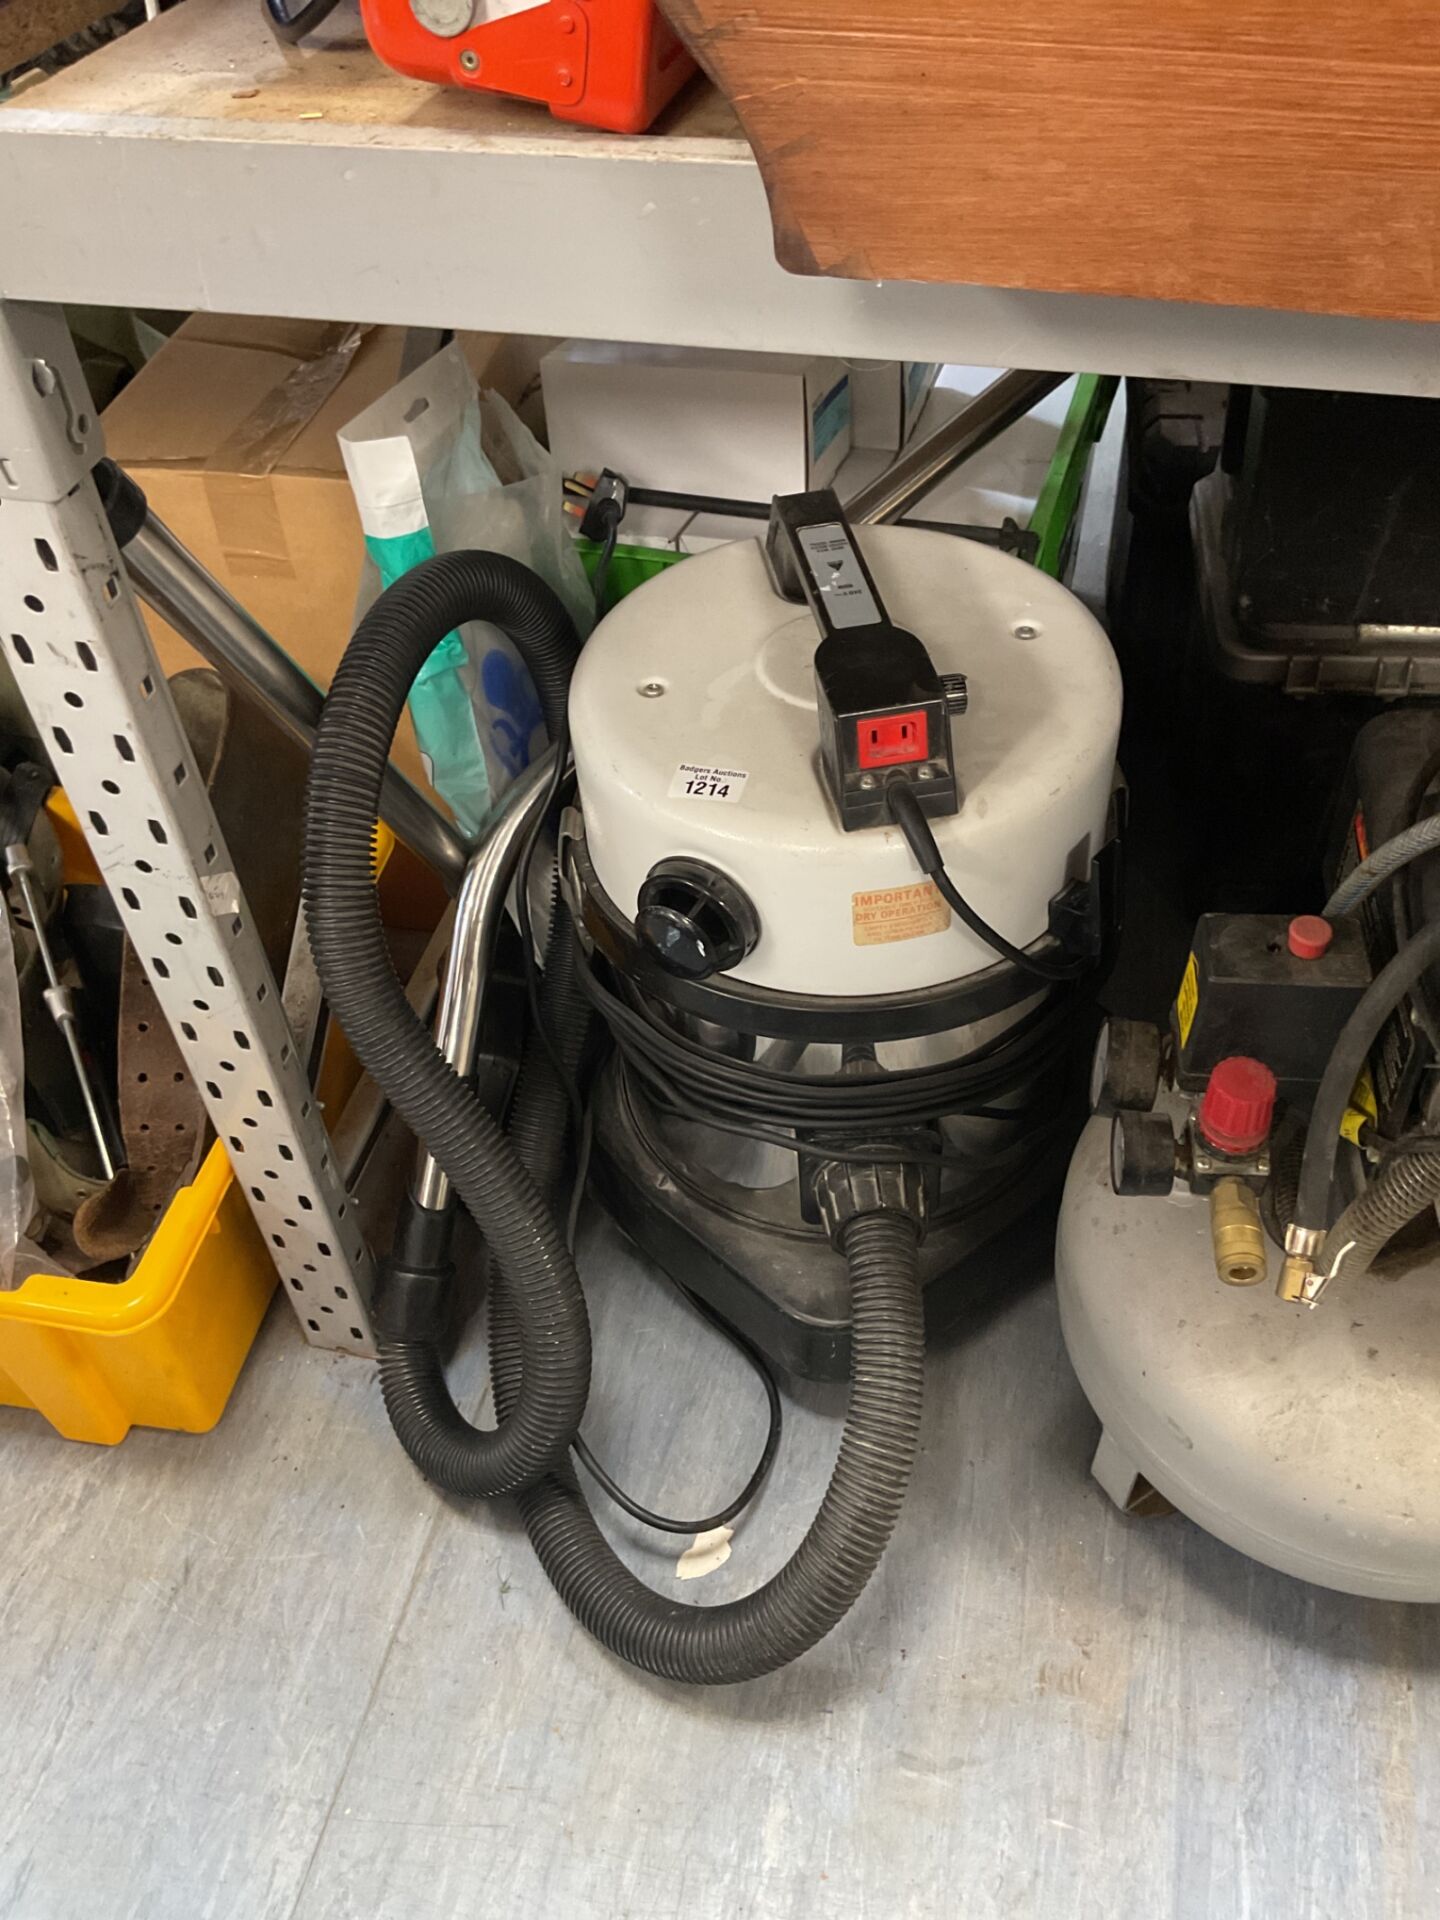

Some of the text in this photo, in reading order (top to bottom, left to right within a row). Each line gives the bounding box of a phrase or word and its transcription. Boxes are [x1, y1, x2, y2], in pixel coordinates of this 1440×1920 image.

[680, 765, 746, 778] Badgers Auctions
[686, 780, 729, 797] 1214
[855, 911, 877, 921] DRY
[880, 902, 941, 919] OPERATION
